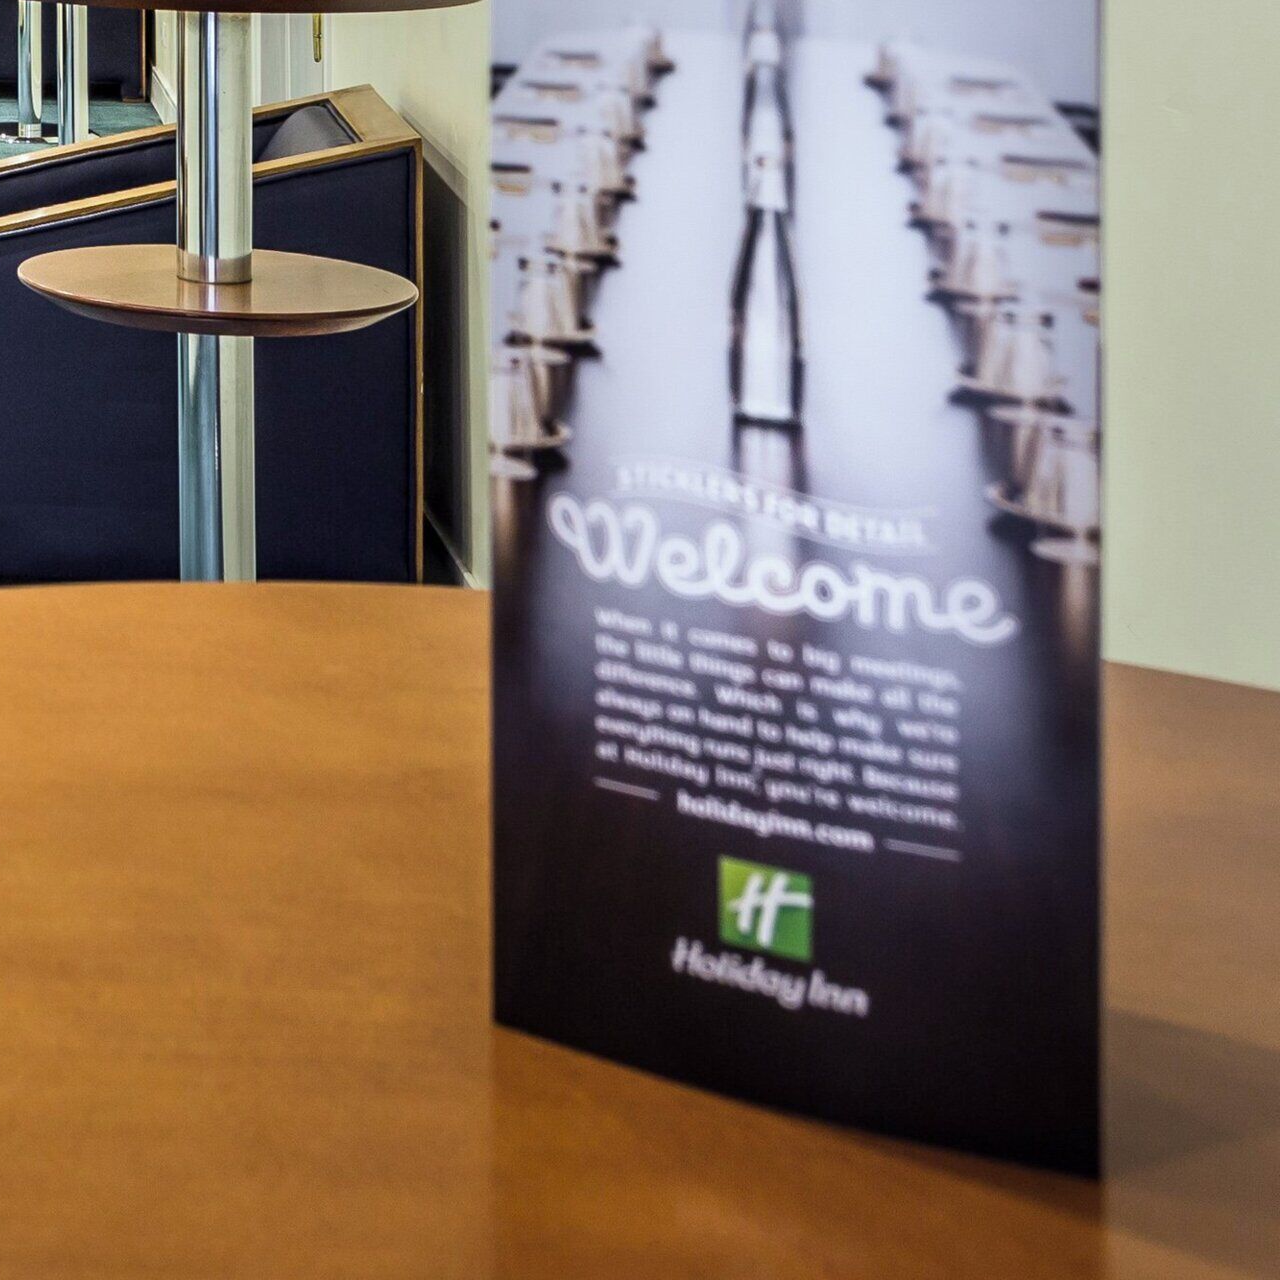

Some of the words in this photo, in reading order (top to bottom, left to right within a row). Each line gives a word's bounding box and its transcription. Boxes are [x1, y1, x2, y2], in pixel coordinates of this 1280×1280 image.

[762, 488, 820, 530] FOR
[547, 493, 1020, 645] Welcome
[594, 633, 631, 659] the
[761, 668, 805, 694] can
[687, 625, 759, 659] comes
[766, 637, 794, 664] to
[594, 739, 620, 764] at
[665, 701, 696, 725] on
[698, 705, 754, 738] hand
[756, 718, 782, 744] to
[785, 723, 836, 757] help
[675, 786, 876, 852] holidayinn.com
[670, 935, 808, 1011] Holiday
[807, 968, 870, 1018] Inn
